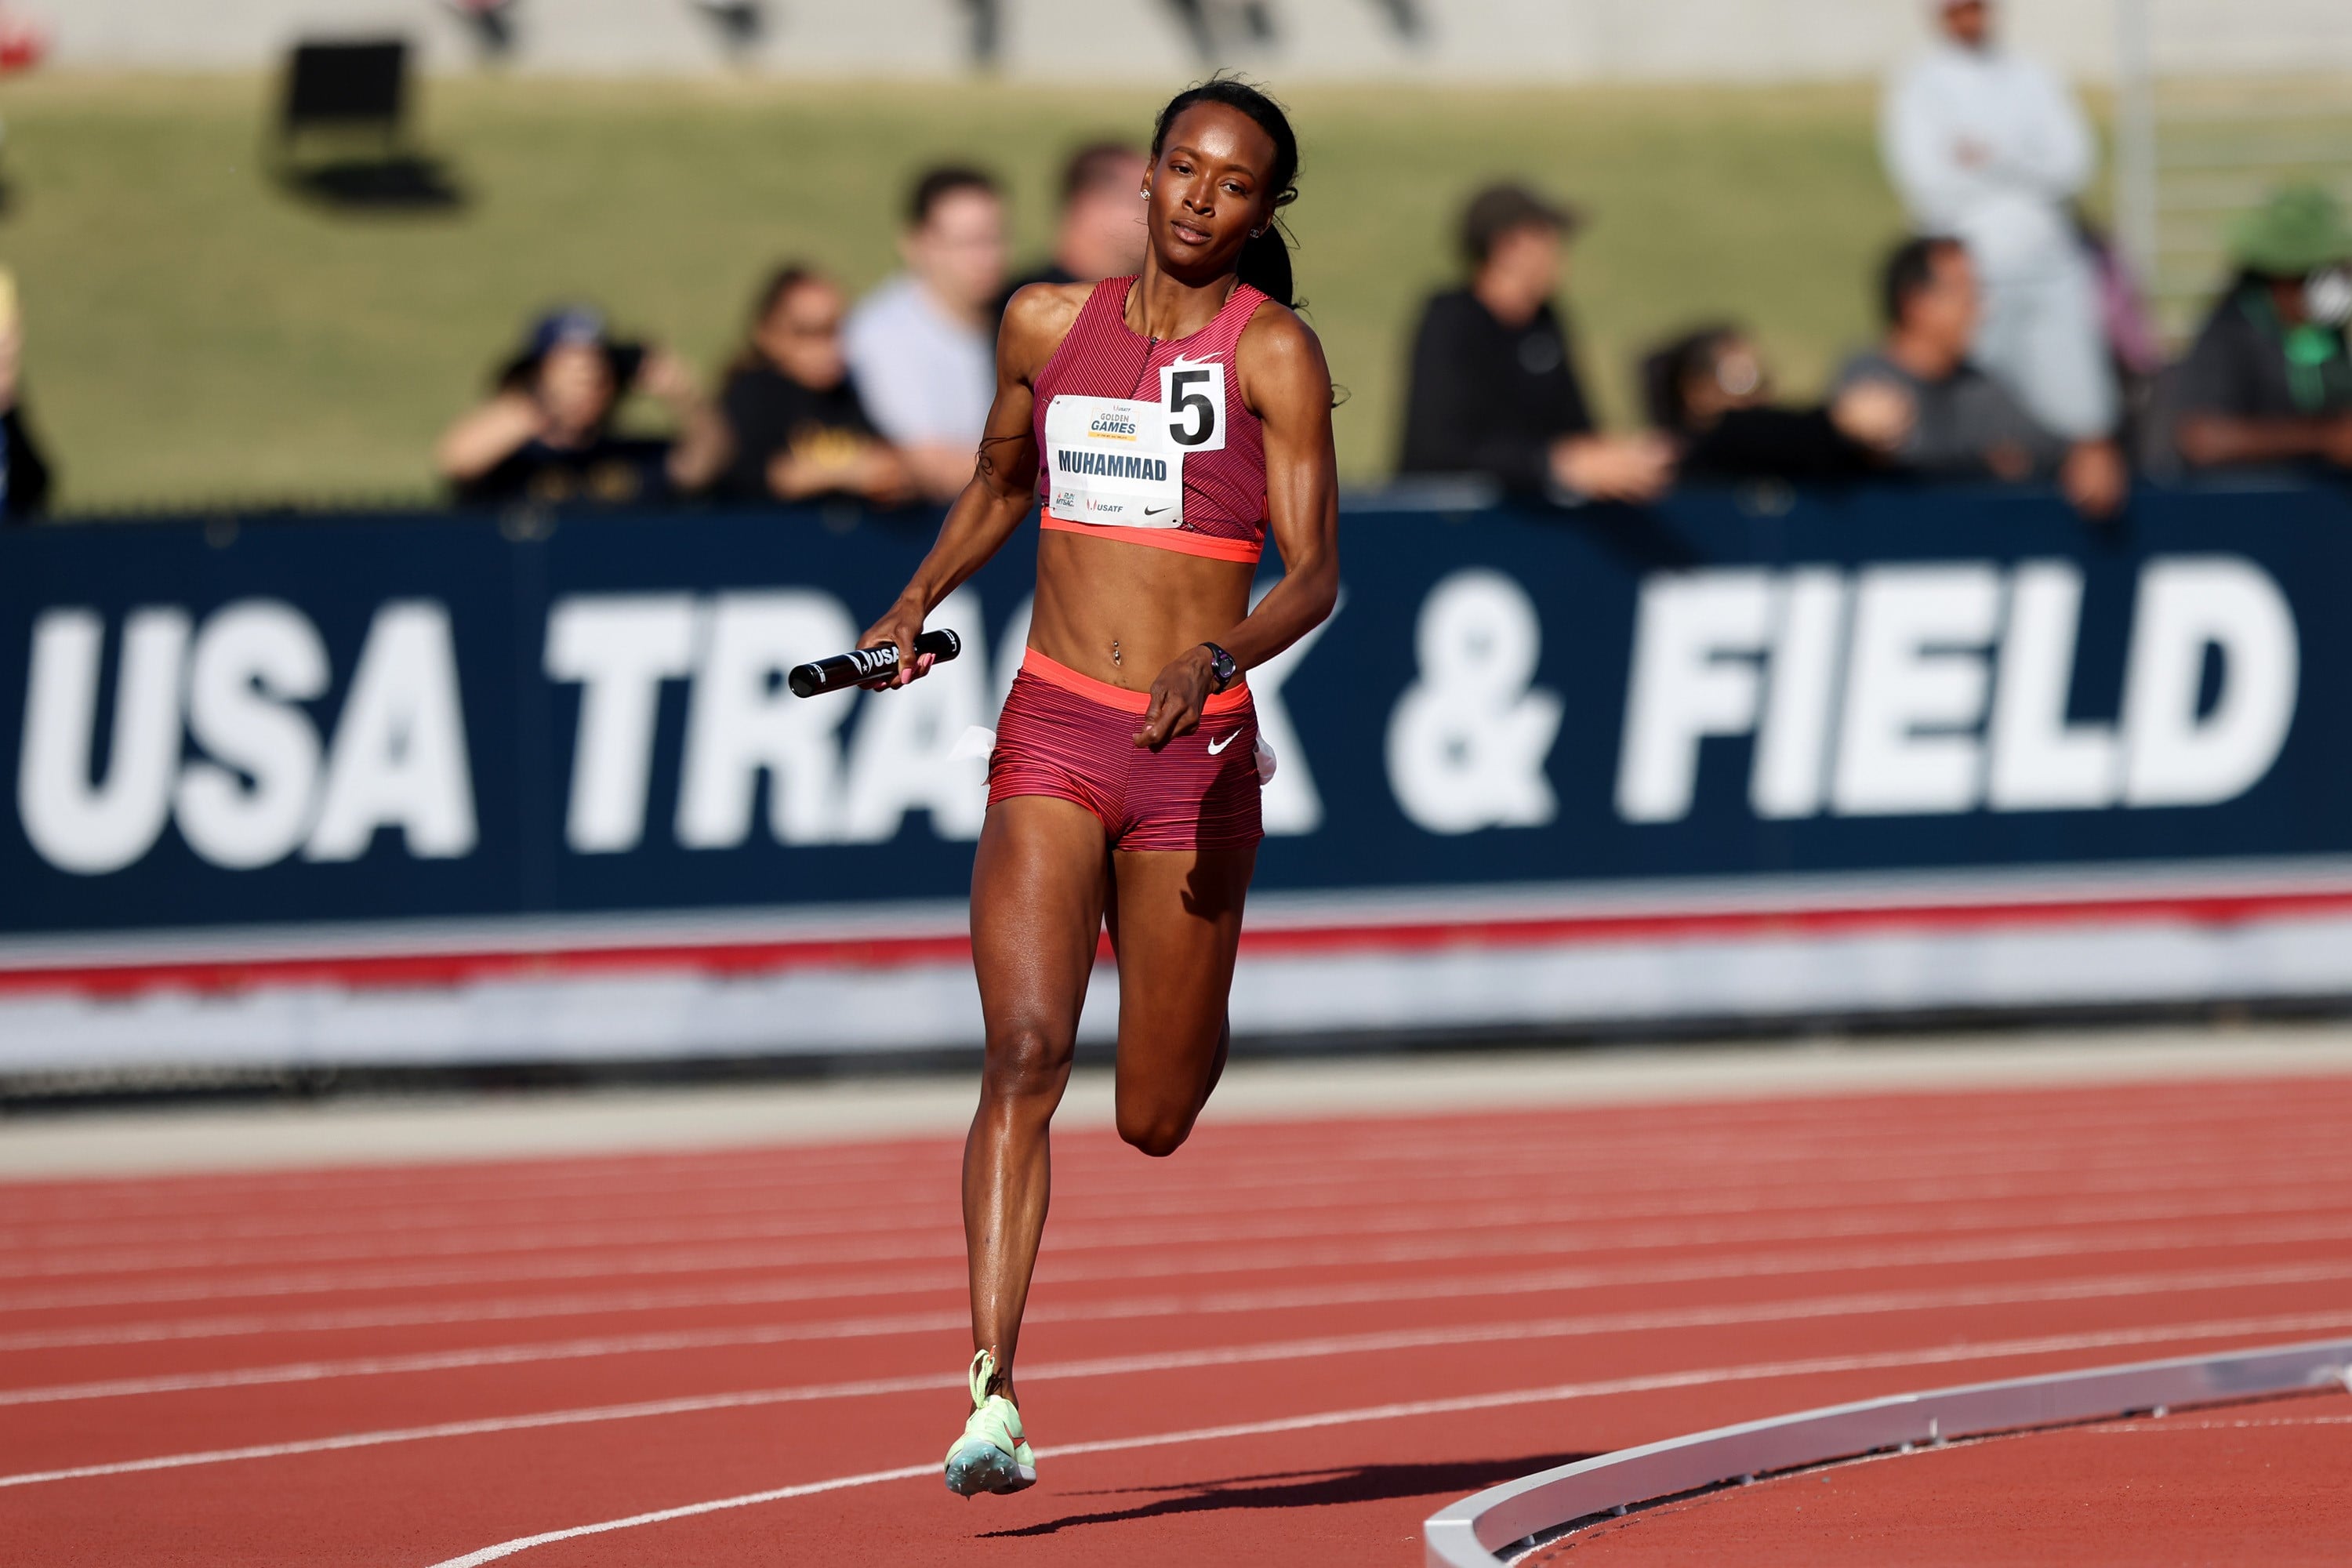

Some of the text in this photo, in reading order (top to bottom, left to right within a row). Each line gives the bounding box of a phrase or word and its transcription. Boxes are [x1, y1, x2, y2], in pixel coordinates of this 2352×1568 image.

[1100, 413, 1130, 423] GOLDEN
[1169, 369, 1214, 446] 5
[1091, 420, 1136, 434] GAMES
[1058, 449, 1167, 481] MUHAMMAD
[1097, 504, 1123, 513] USATF
[17, 551, 2301, 875] USA TRAK & FIELD
